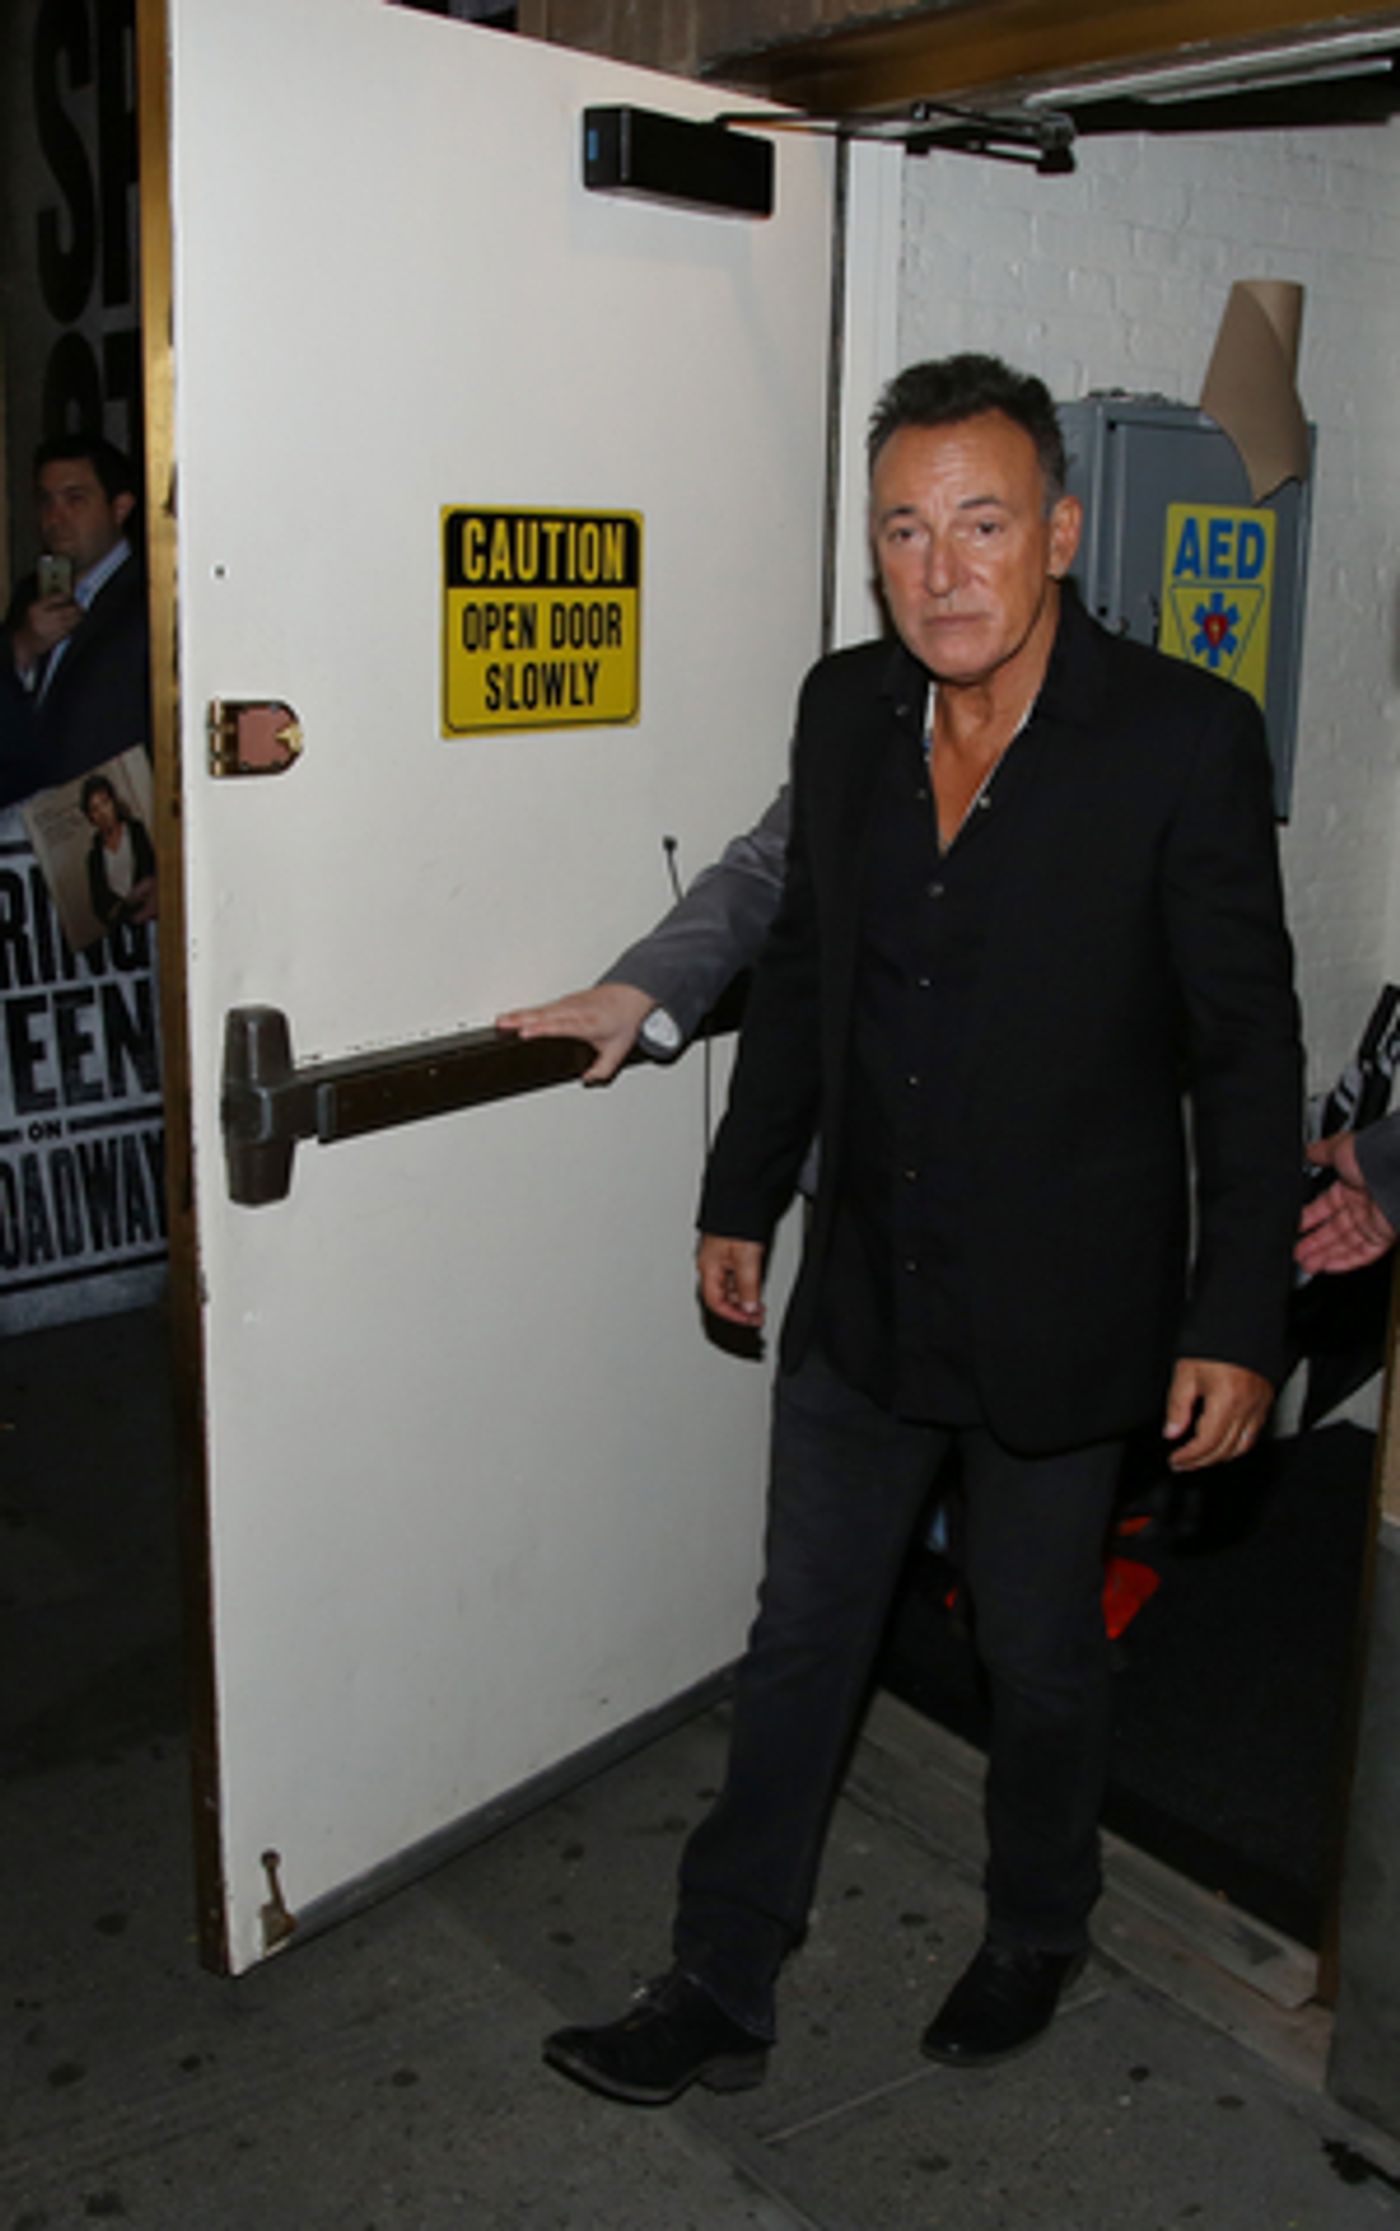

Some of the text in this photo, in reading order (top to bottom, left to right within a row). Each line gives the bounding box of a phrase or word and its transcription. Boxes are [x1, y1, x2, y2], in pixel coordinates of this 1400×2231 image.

[463, 517, 625, 581] CAUTION
[1173, 517, 1266, 579] AED
[462, 602, 622, 652] OPEN DOOR
[486, 660, 600, 711] SLOWLY
[28, 1121, 62, 1142] ON
